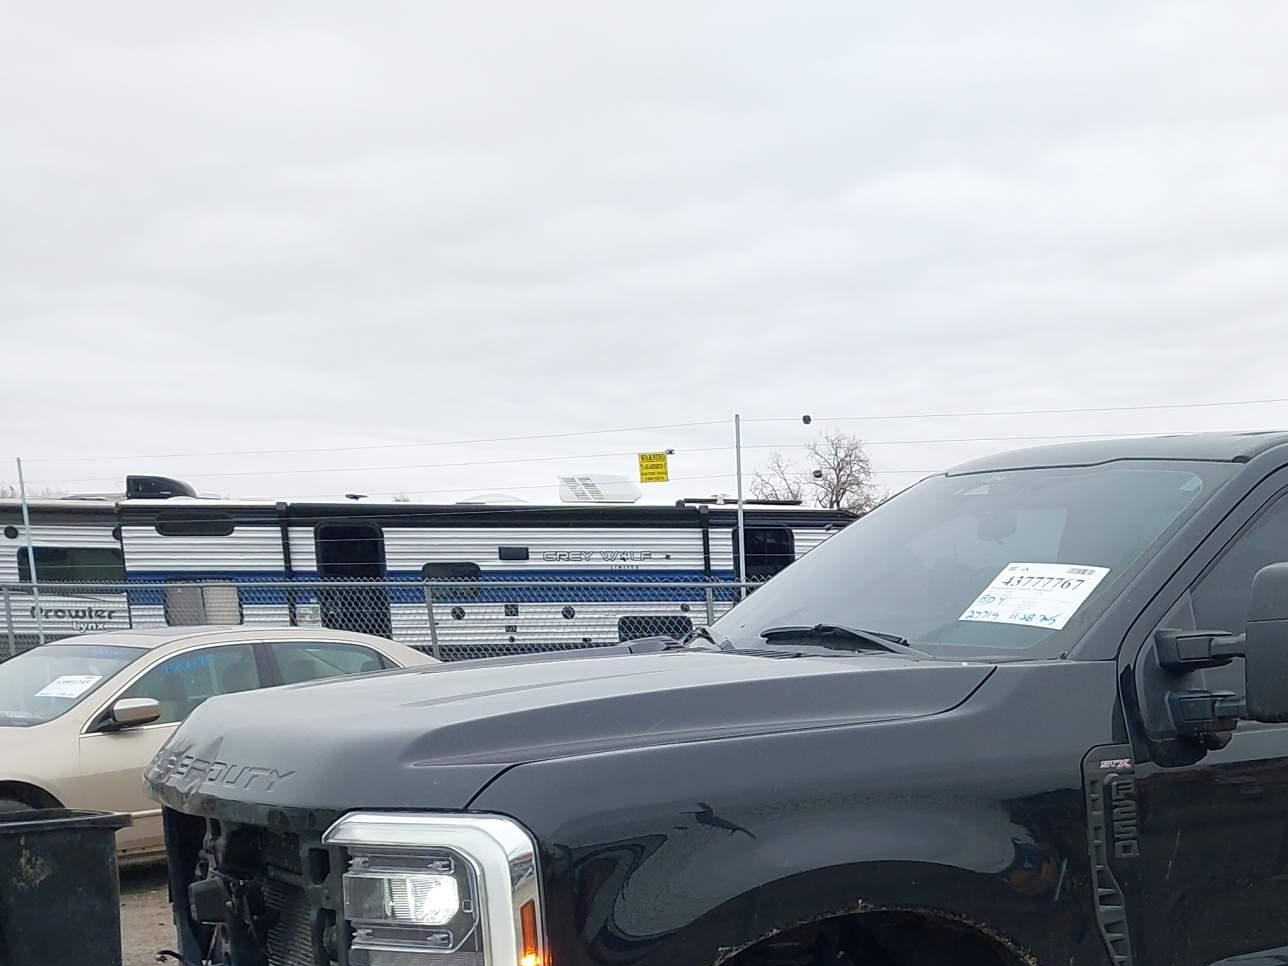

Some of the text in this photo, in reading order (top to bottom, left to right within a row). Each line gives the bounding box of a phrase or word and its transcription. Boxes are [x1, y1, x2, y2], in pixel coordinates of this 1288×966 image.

[542, 550, 586, 560] GREY
[1002, 575, 1086, 591] 43777767
[73, 621, 105, 633] Lynx
[1100, 758, 1135, 769] STX
[205, 759, 296, 793] DUTY
